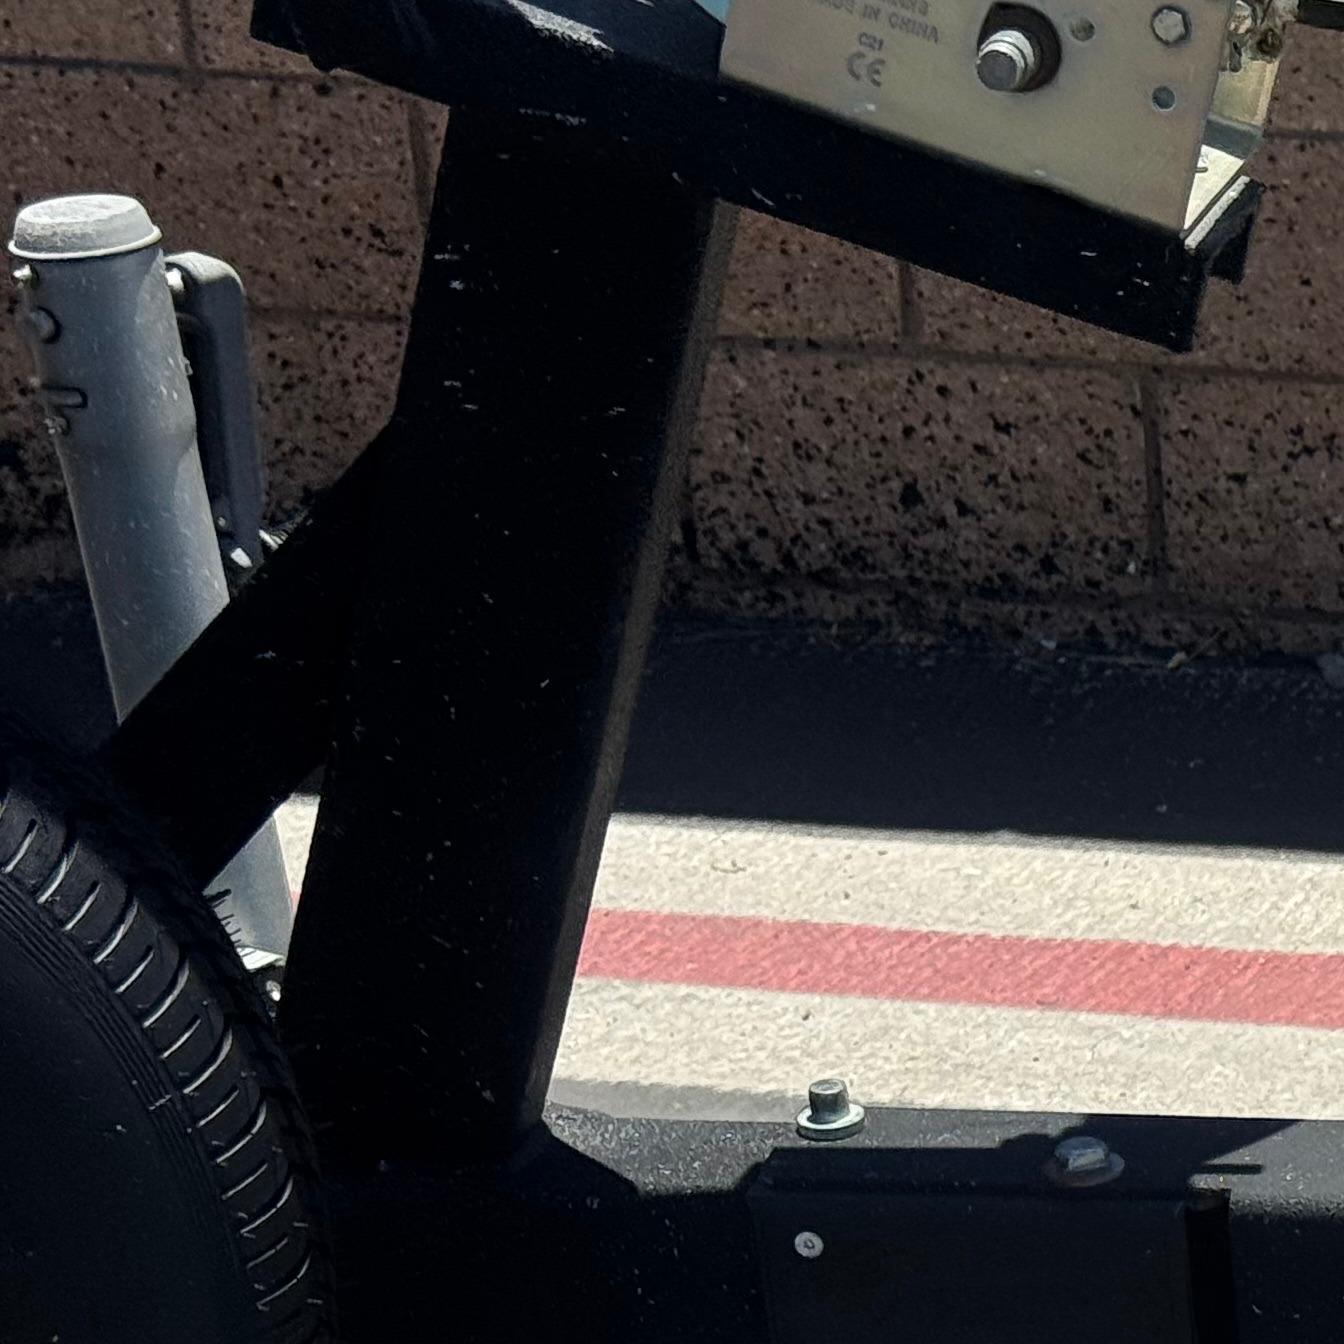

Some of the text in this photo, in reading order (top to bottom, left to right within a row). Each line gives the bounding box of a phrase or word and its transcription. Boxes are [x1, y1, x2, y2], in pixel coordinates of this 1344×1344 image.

[862, 4, 881, 21] IN
[888, 12, 939, 44] CHINA
[847, 51, 886, 87] CE
